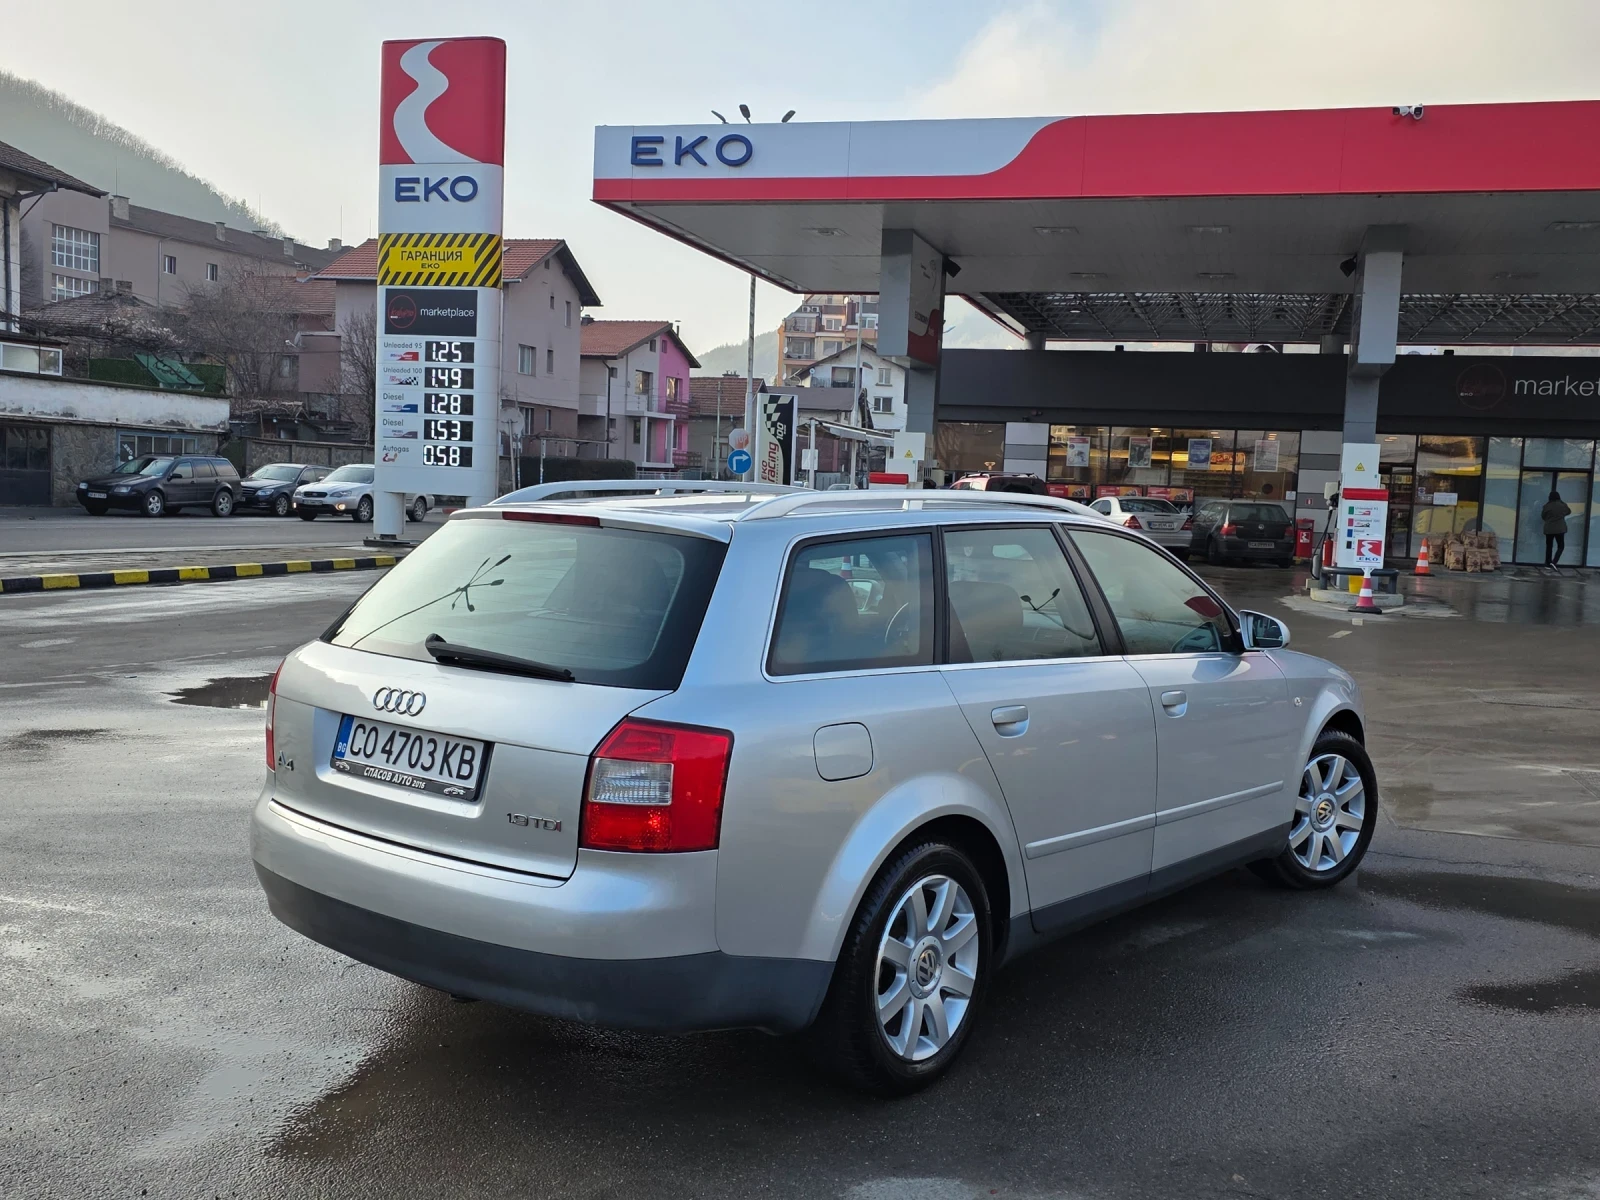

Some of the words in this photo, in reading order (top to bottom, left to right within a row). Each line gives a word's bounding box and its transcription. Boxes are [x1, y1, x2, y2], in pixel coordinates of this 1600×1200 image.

[631, 133, 753, 167] EKO
[394, 175, 479, 203] EKO
[400, 250, 463, 263] ГАРАНЦИЯ
[420, 262, 440, 270] EKO
[420, 306, 475, 319] marketplace
[383, 341, 413, 349] Unleaded
[432, 341, 462, 362] 1.25
[383, 366, 411, 374] Unleaded
[432, 368, 462, 389] 1.49
[382, 392, 404, 401] Diesel
[431, 393, 461, 414] 1.28
[382, 418, 404, 427] Diesel
[431, 420, 461, 441] 1.53
[776, 421, 784, 440] 100
[382, 444, 410, 454] Autogas
[423, 445, 461, 466] 0.58
[767, 441, 780, 483] racing
[337, 741, 347, 753] BG
[363, 766, 392, 781] СПАСОВ
[391, 773, 413, 786] АУТО
[411, 779, 427, 789] 2016
[529, 815, 562, 833] TDI
